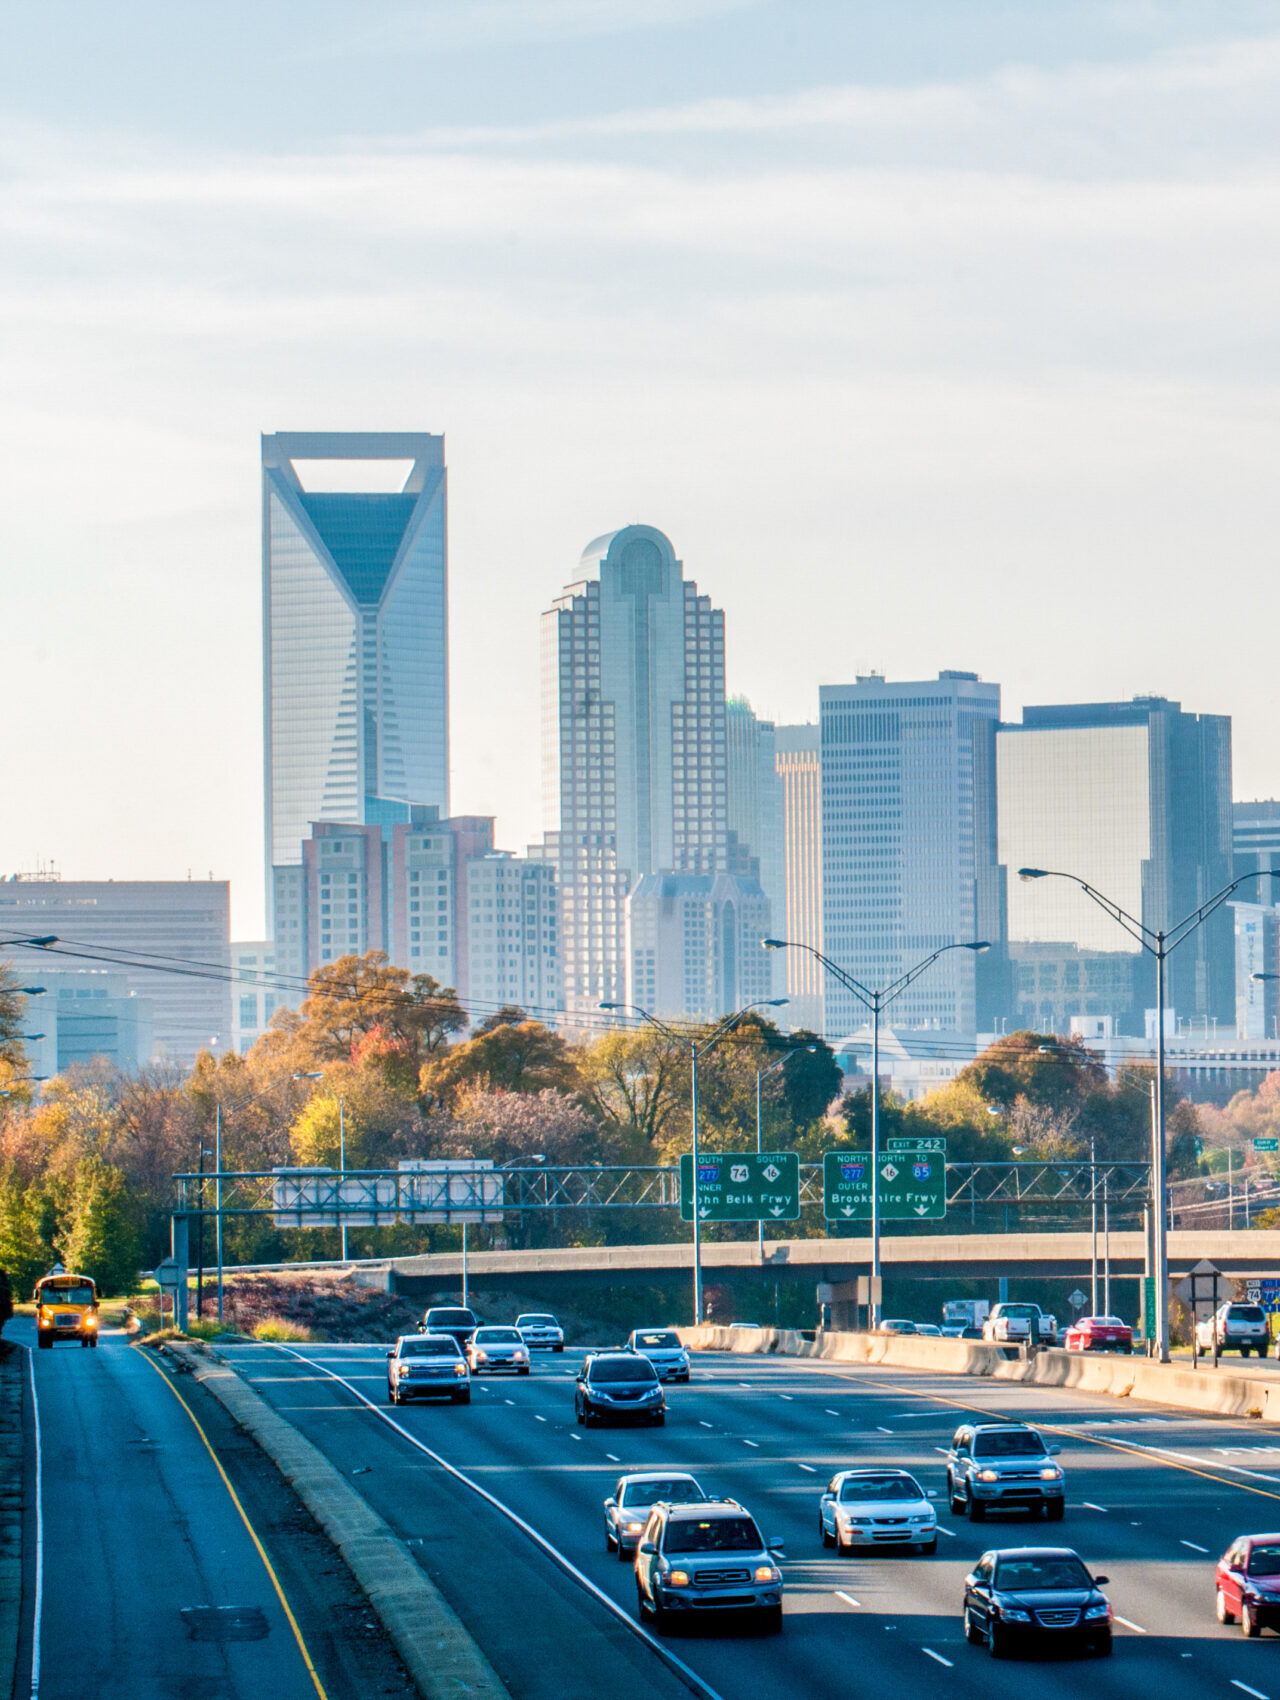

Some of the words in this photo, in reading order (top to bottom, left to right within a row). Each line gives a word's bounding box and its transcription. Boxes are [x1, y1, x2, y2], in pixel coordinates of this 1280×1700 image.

[917, 1140, 941, 1149] 242
[698, 1156, 723, 1164] OUTH
[756, 1155, 787, 1163] SOUTH
[699, 1170, 717, 1179] 277
[732, 1169, 747, 1178] 74
[767, 1168, 777, 1177] 16
[845, 1169, 861, 1179] 277
[885, 1168, 896, 1177] 16
[914, 1167, 930, 1177] 85
[838, 1182, 868, 1190] OUTER
[726, 1194, 754, 1204] Belk
[760, 1194, 792, 1206] Frwy
[906, 1192, 938, 1204] Frwy
[1249, 1291, 1260, 1299] 74
[1264, 1291, 1275, 1301] 77
